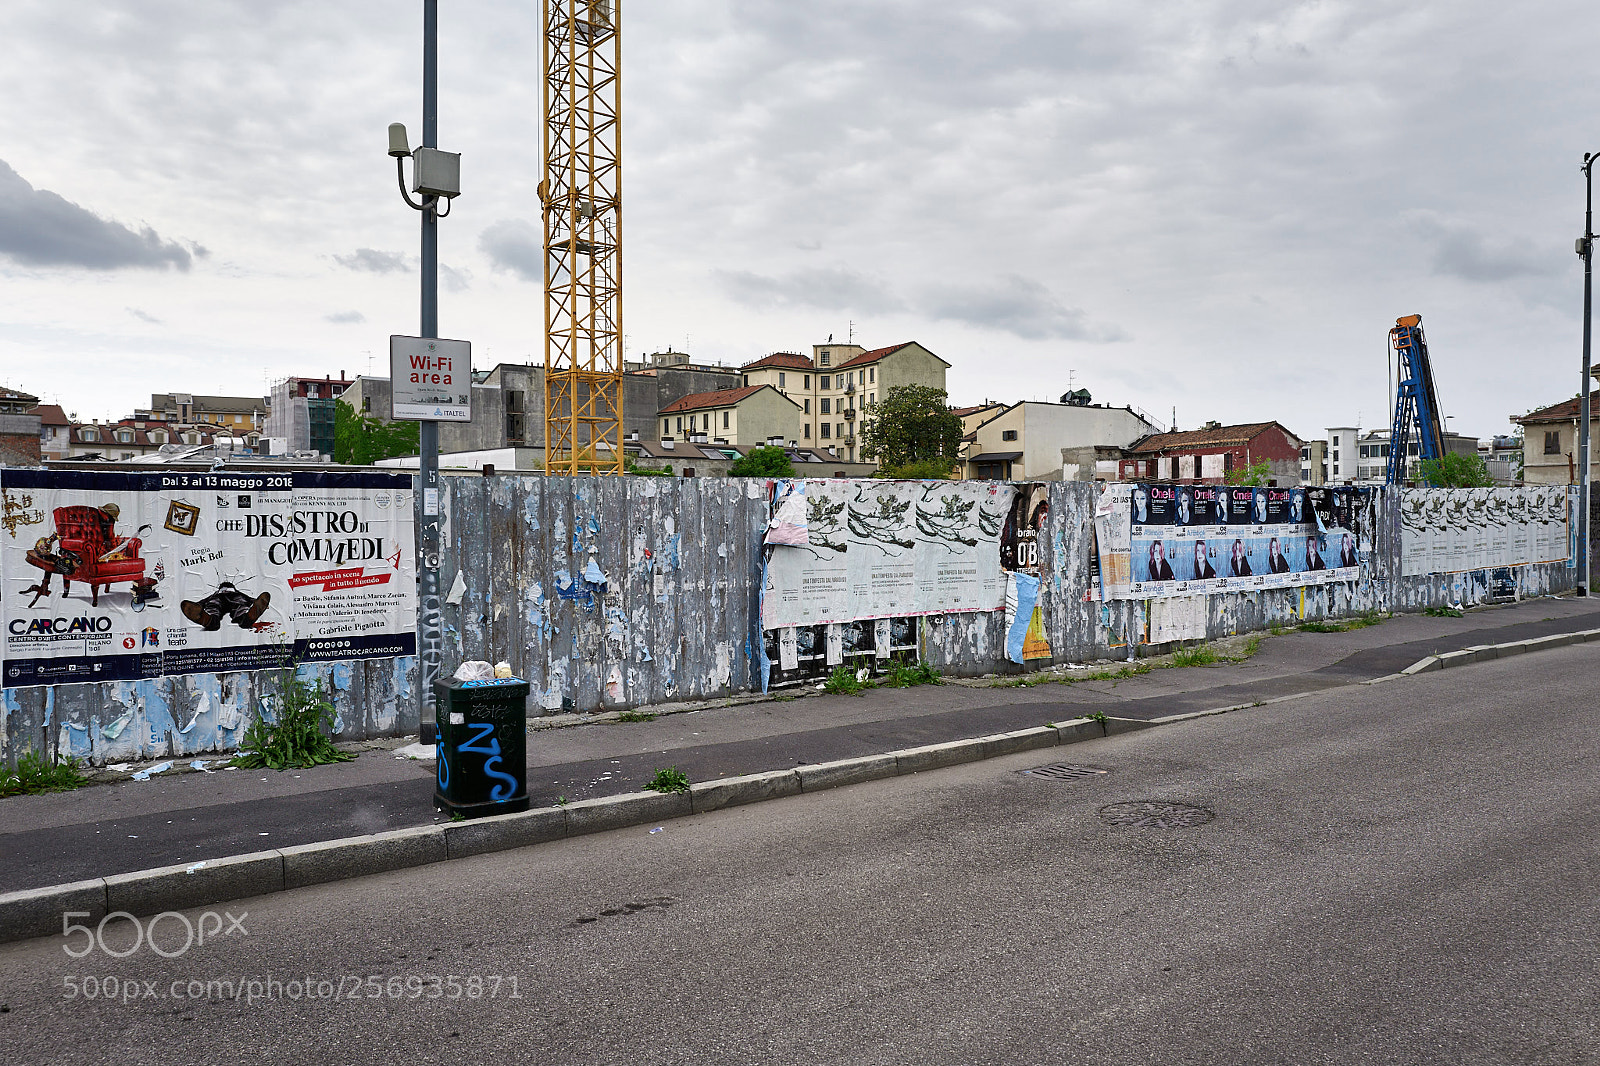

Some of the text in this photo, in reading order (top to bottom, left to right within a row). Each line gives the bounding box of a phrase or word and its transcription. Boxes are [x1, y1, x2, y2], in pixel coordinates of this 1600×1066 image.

[409, 355, 452, 371] Wi-Fi
[410, 372, 452, 385] area
[162, 477, 179, 486] Dal
[181, 476, 188, 486] 3
[192, 478, 202, 486] al
[205, 476, 217, 486] 13
[216, 511, 369, 537] CHE DISASTRO DI
[191, 547, 211, 556] Regia
[180, 555, 207, 567] Mark
[8, 616, 113, 635] CARCANO
[319, 624, 353, 636] Gabriele
